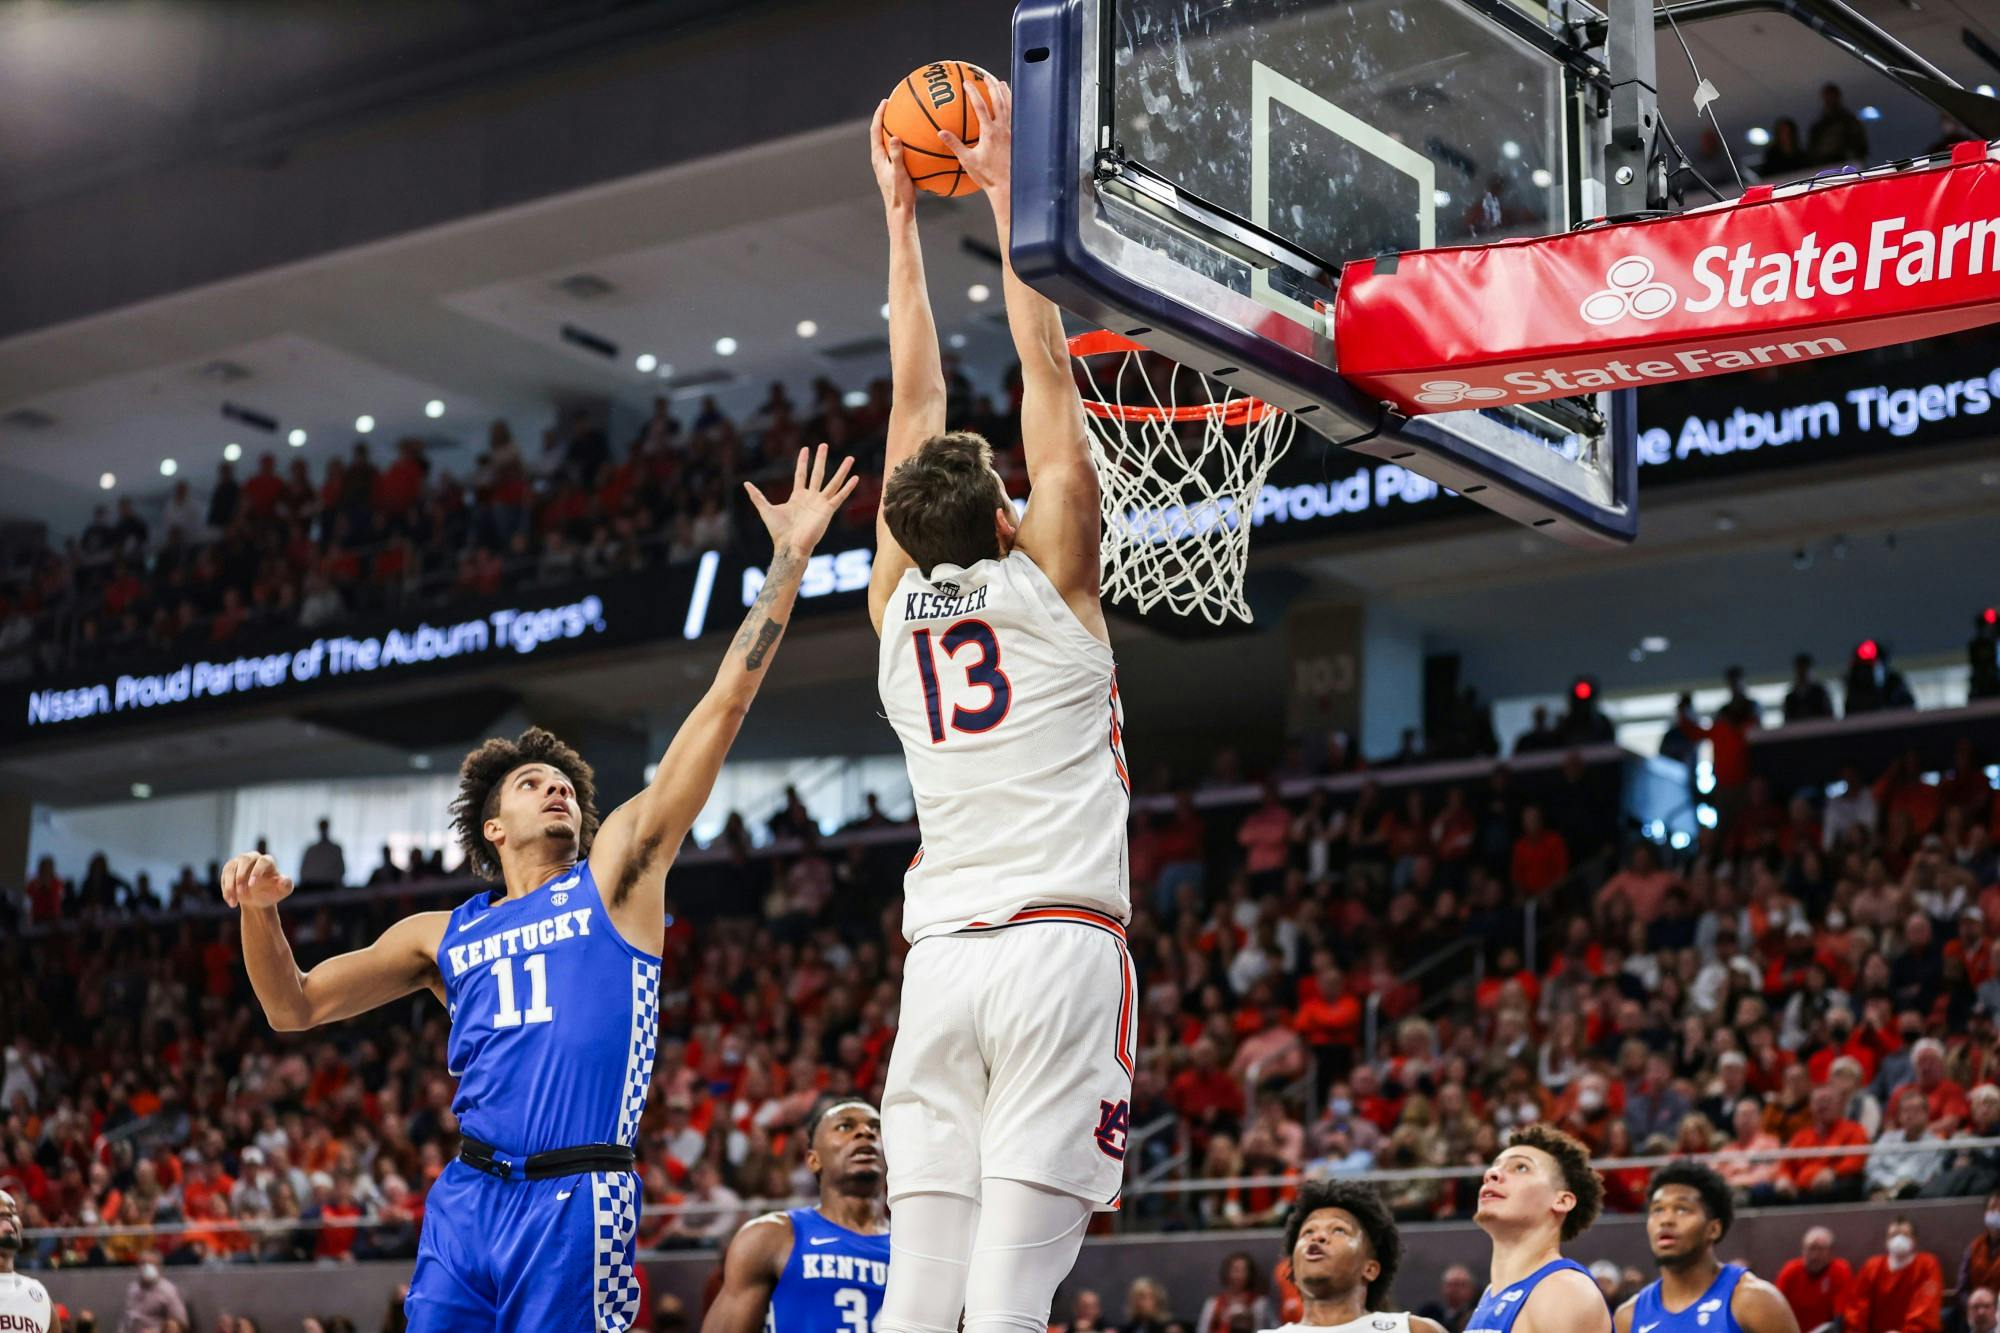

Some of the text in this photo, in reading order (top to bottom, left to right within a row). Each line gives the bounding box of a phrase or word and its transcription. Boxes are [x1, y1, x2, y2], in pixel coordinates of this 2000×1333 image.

[1252, 466, 1370, 526] Proud
[1375, 464, 1462, 507] Par
[1676, 399, 1841, 461] Auburn
[904, 584, 987, 621] KESSLER
[28, 683, 112, 726] Nissan
[114, 664, 191, 712] Proud
[192, 652, 292, 698] Partner
[292, 637, 326, 682] of
[326, 638, 381, 675] The
[381, 618, 490, 667] Auburn
[912, 618, 1012, 744] 13
[447, 908, 592, 977] KENTUCKY
[490, 953, 553, 1029] 11
[802, 1253, 888, 1286] KENTU
